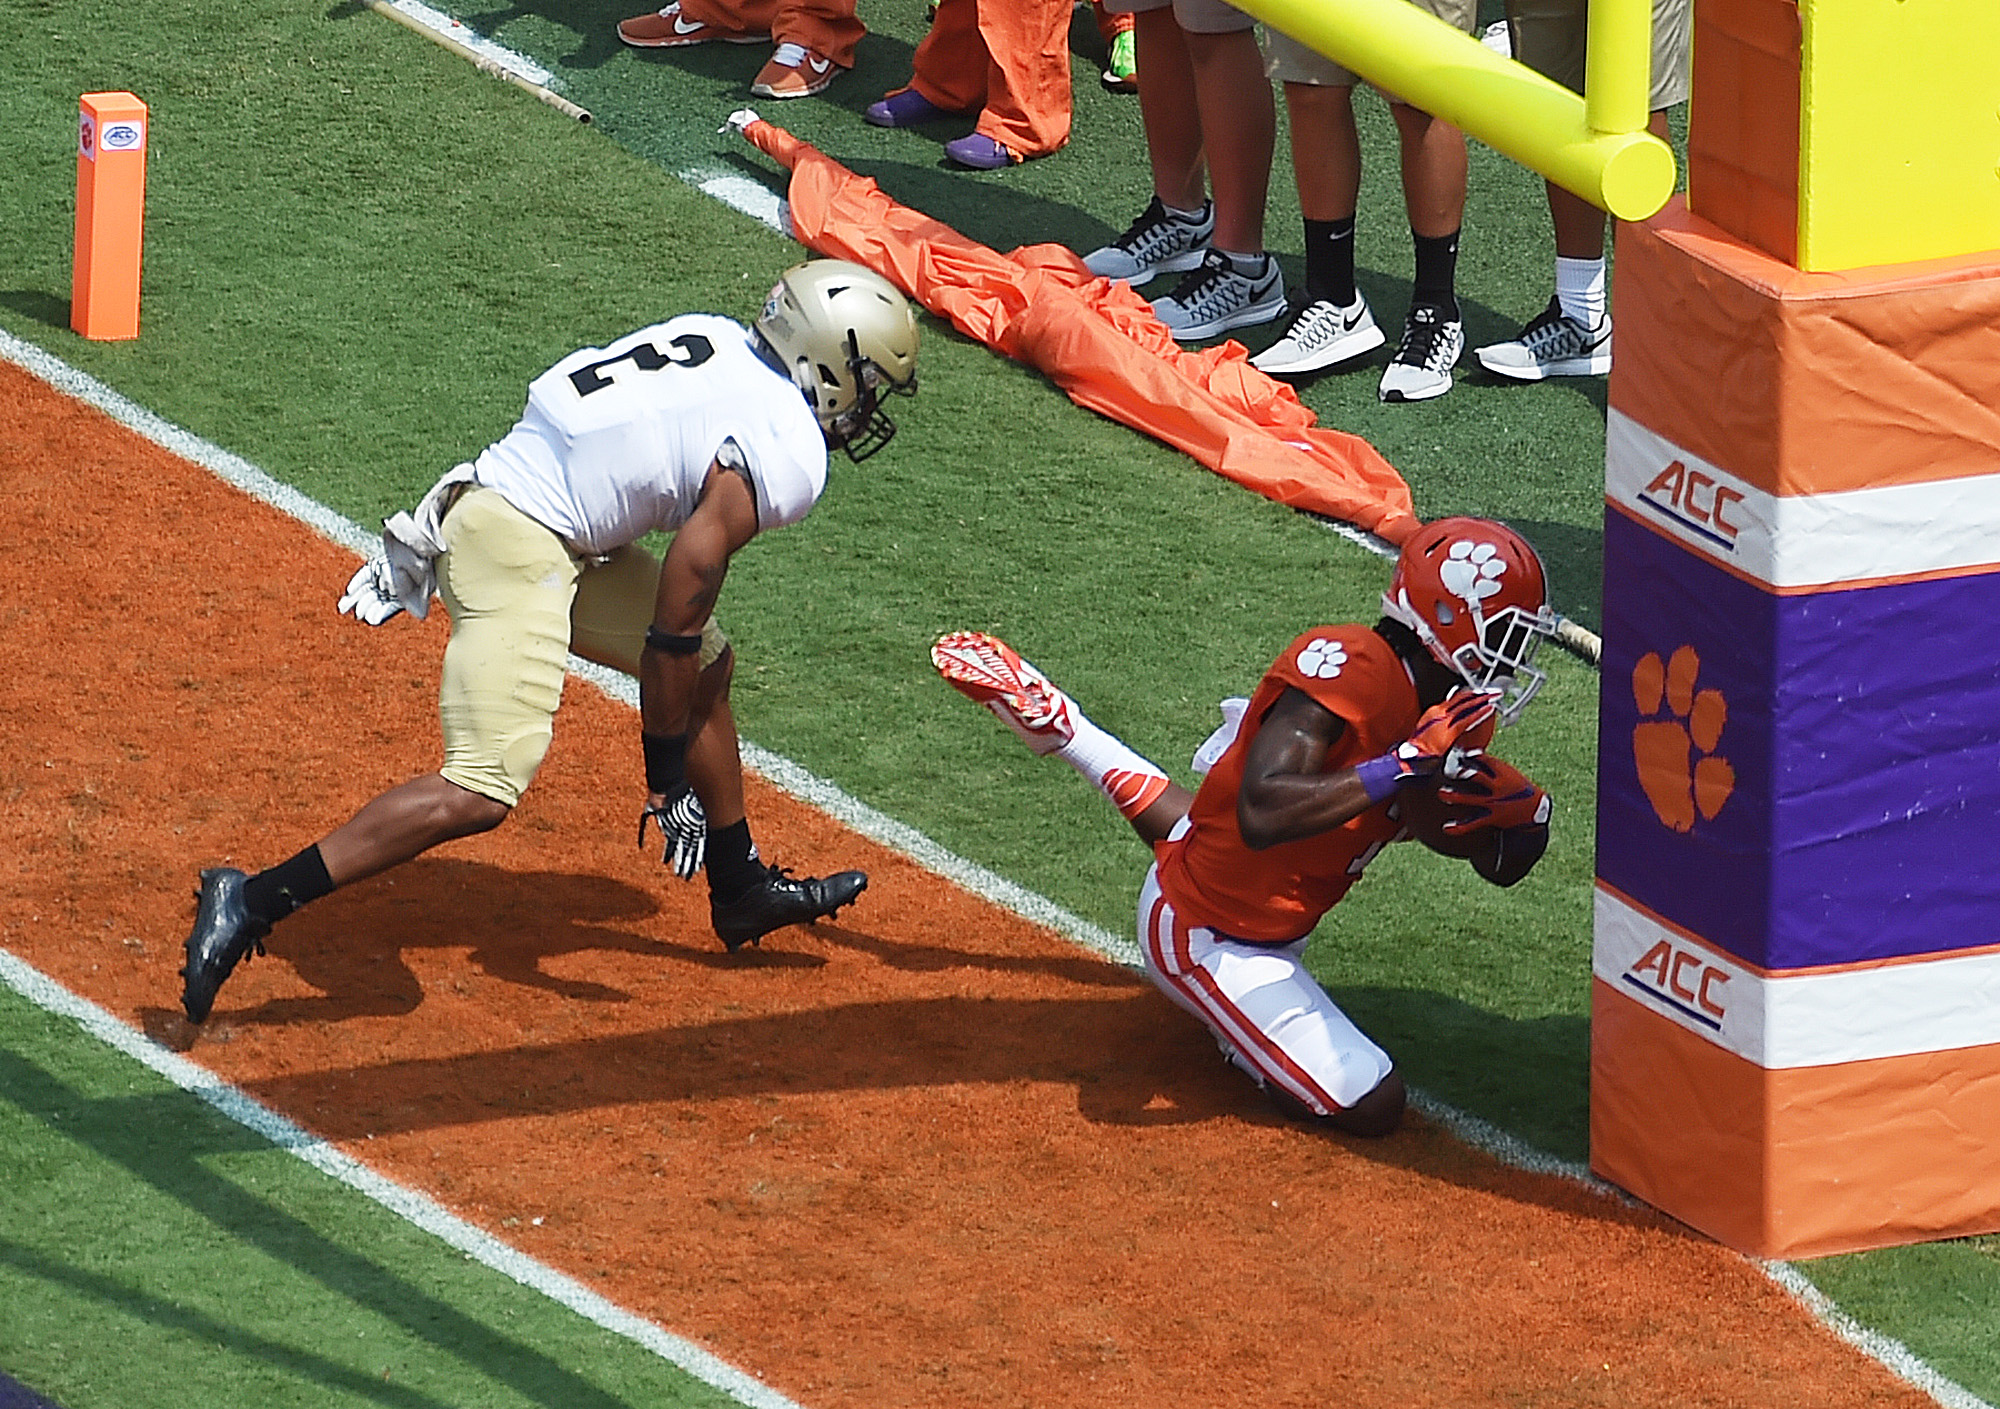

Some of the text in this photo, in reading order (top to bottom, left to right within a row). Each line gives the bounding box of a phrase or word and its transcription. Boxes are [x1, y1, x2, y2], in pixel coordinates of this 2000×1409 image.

[568, 334, 716, 397] 2
[1645, 460, 1745, 539] ACC
[1632, 940, 1731, 1019] ACC
